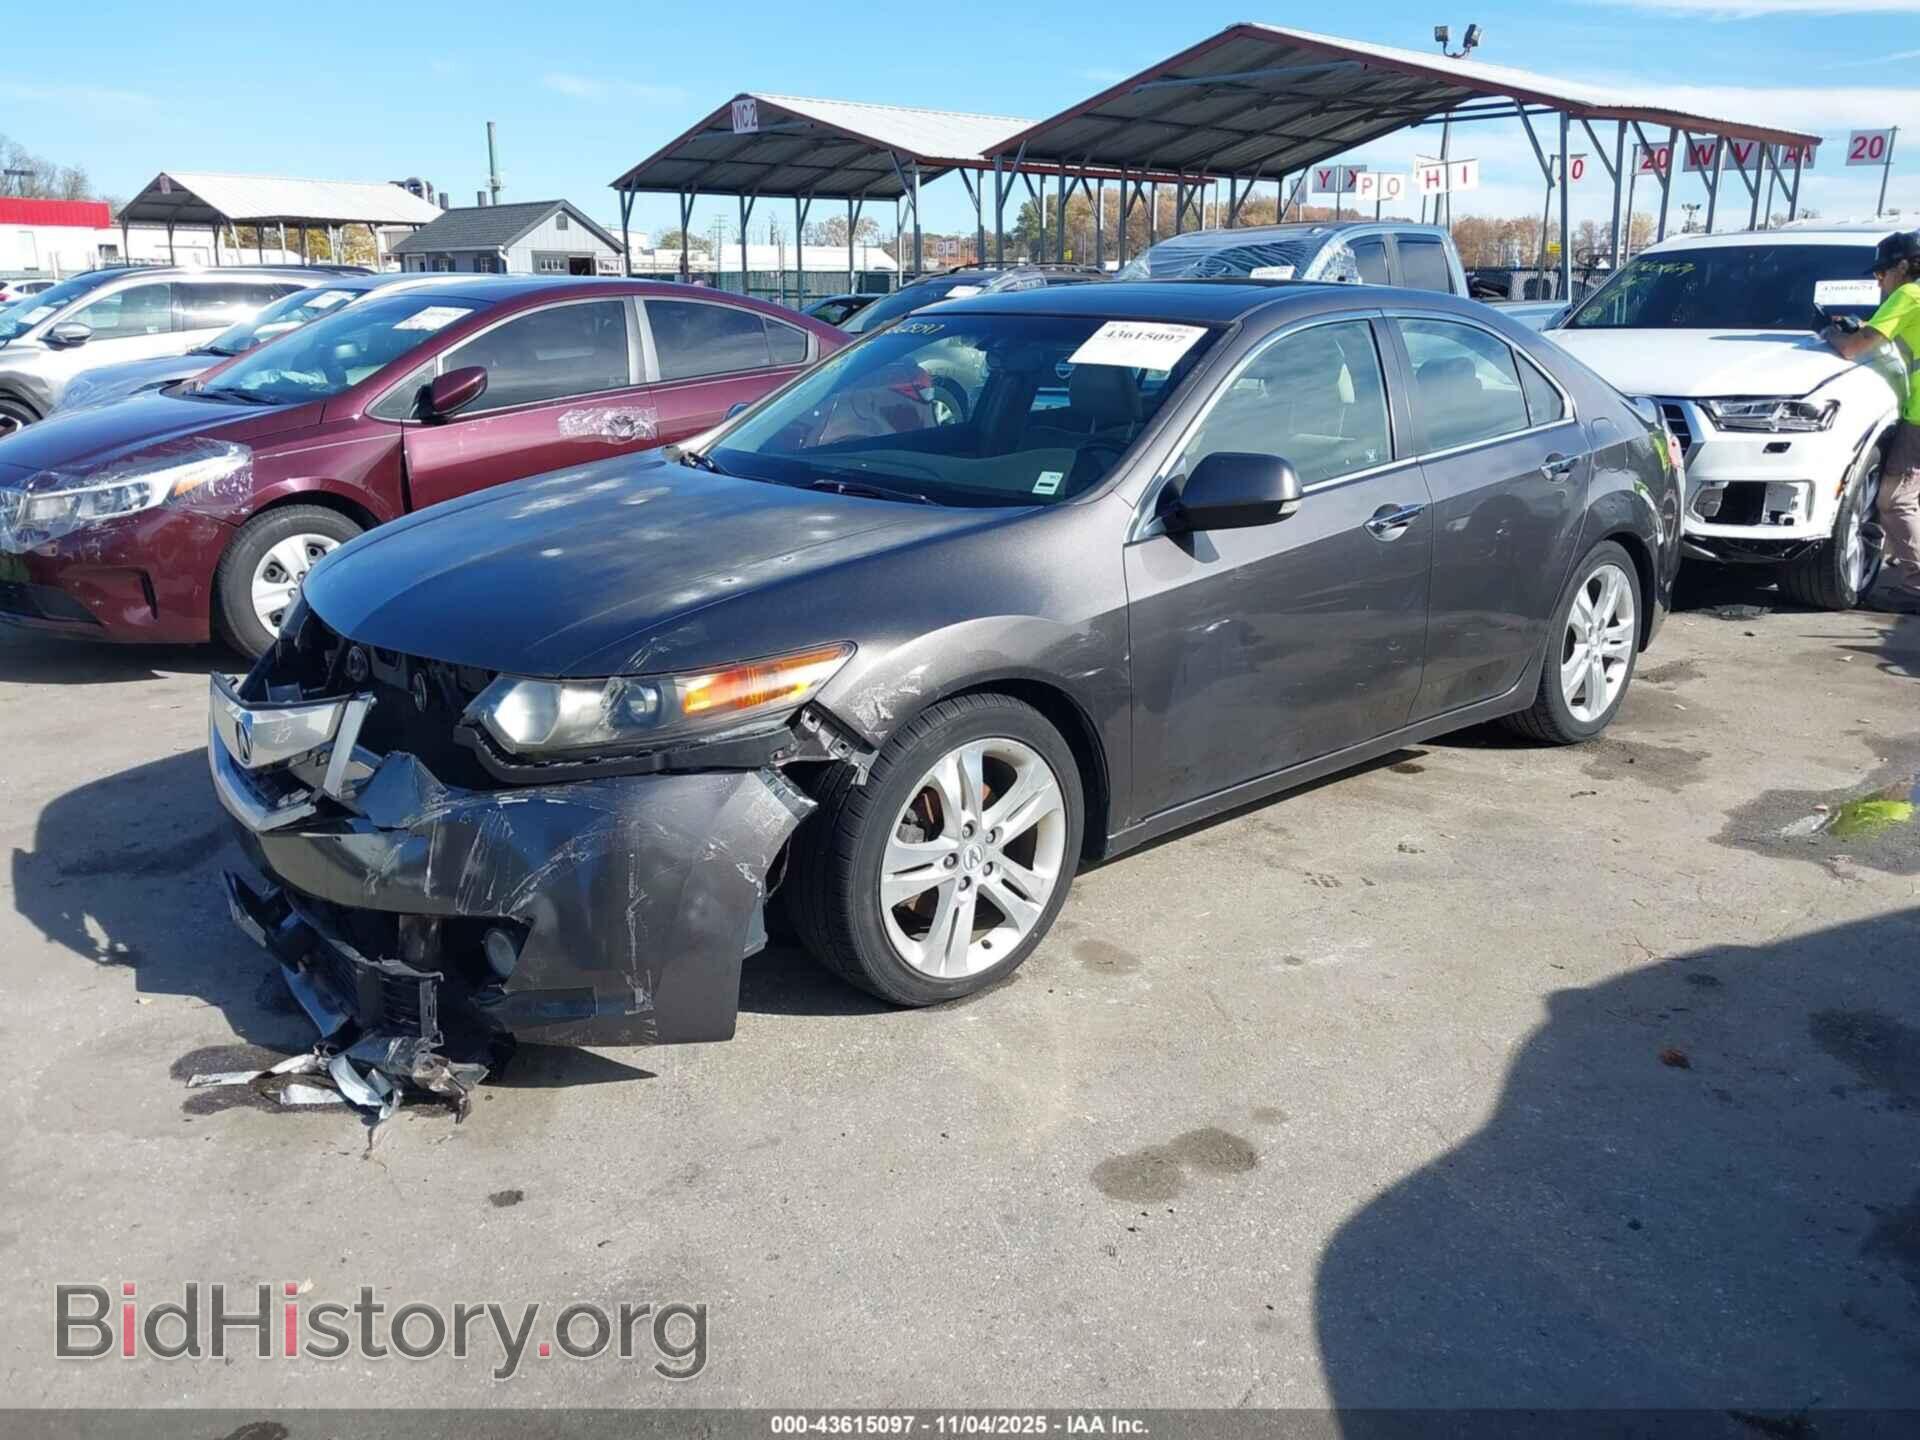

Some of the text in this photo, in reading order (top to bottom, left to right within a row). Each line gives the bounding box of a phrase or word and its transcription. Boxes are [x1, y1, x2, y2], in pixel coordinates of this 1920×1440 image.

[1850, 135, 1884, 160] 20
[1318, 170, 1332, 189] Y
[1361, 177, 1374, 195] P
[1425, 169, 1441, 189] H
